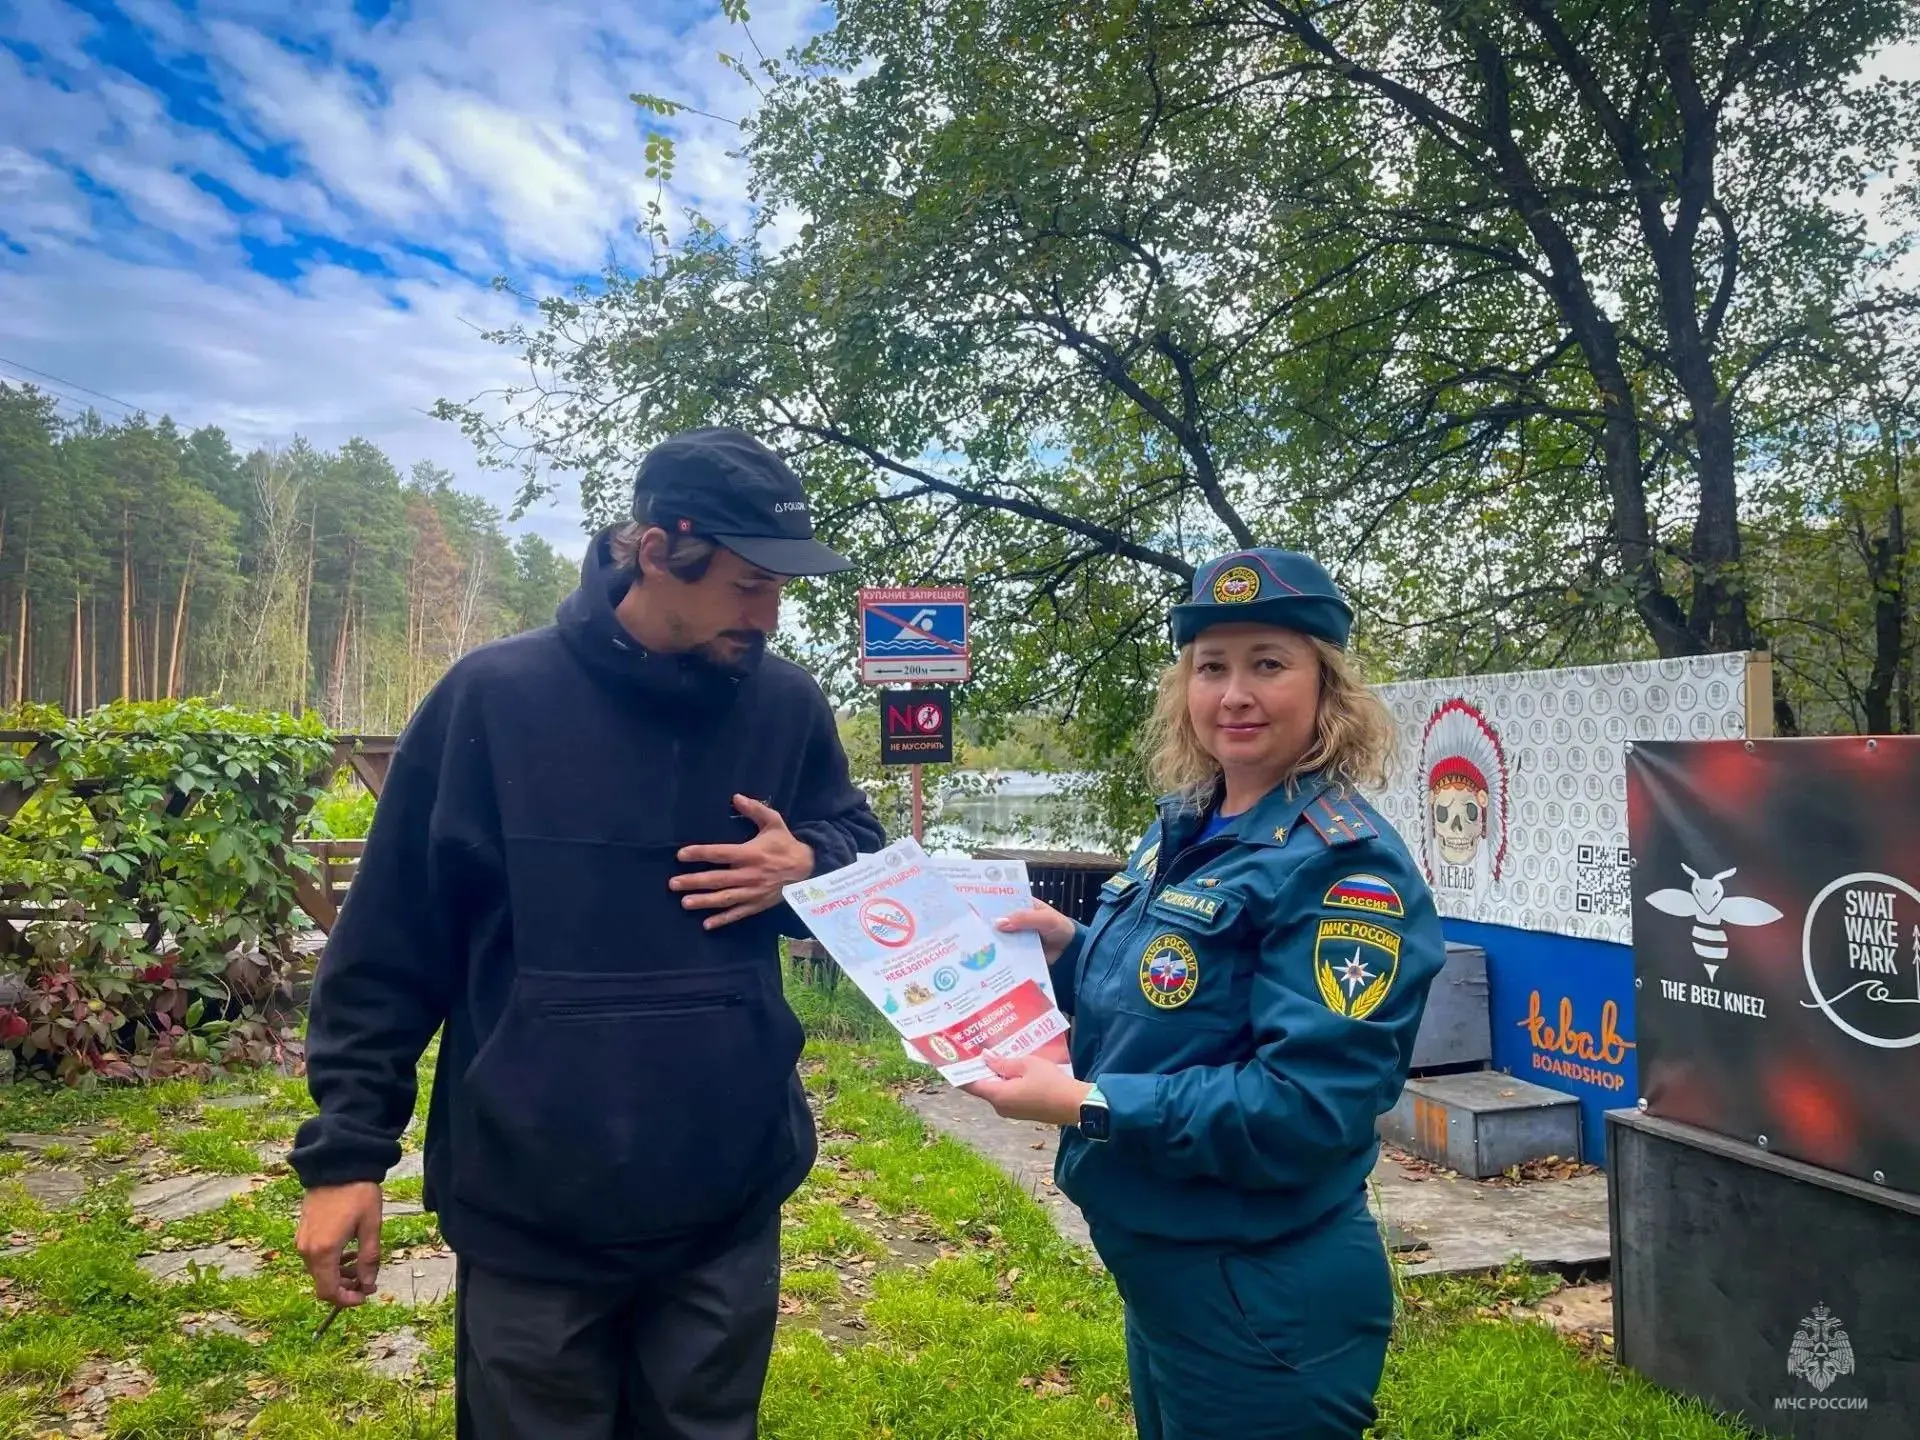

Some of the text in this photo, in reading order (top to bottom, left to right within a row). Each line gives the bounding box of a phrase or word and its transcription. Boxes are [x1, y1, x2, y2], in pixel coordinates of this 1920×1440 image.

[863, 590, 966, 601] КУПАНИЕ ЗАПРЕЩЕНО
[890, 741, 945, 751] НЕ МУСОРИТЬ
[1440, 865, 1475, 890] KEBAB
[1341, 895, 1388, 910] РОССИЯ
[1845, 889, 1897, 920] SWAT
[1322, 922, 1398, 950] МЧС РОССИИ
[1844, 915, 1899, 948] WAKE
[1145, 937, 1196, 971] МЧС РОССИИ
[1848, 942, 1898, 975] PARK
[1142, 971, 1195, 1005] EMERCOM
[1660, 979, 1767, 1018] THE BEEZ KNEEZ
[1516, 990, 1637, 1065] kebab
[1532, 1052, 1625, 1092] BOARDSHOP
